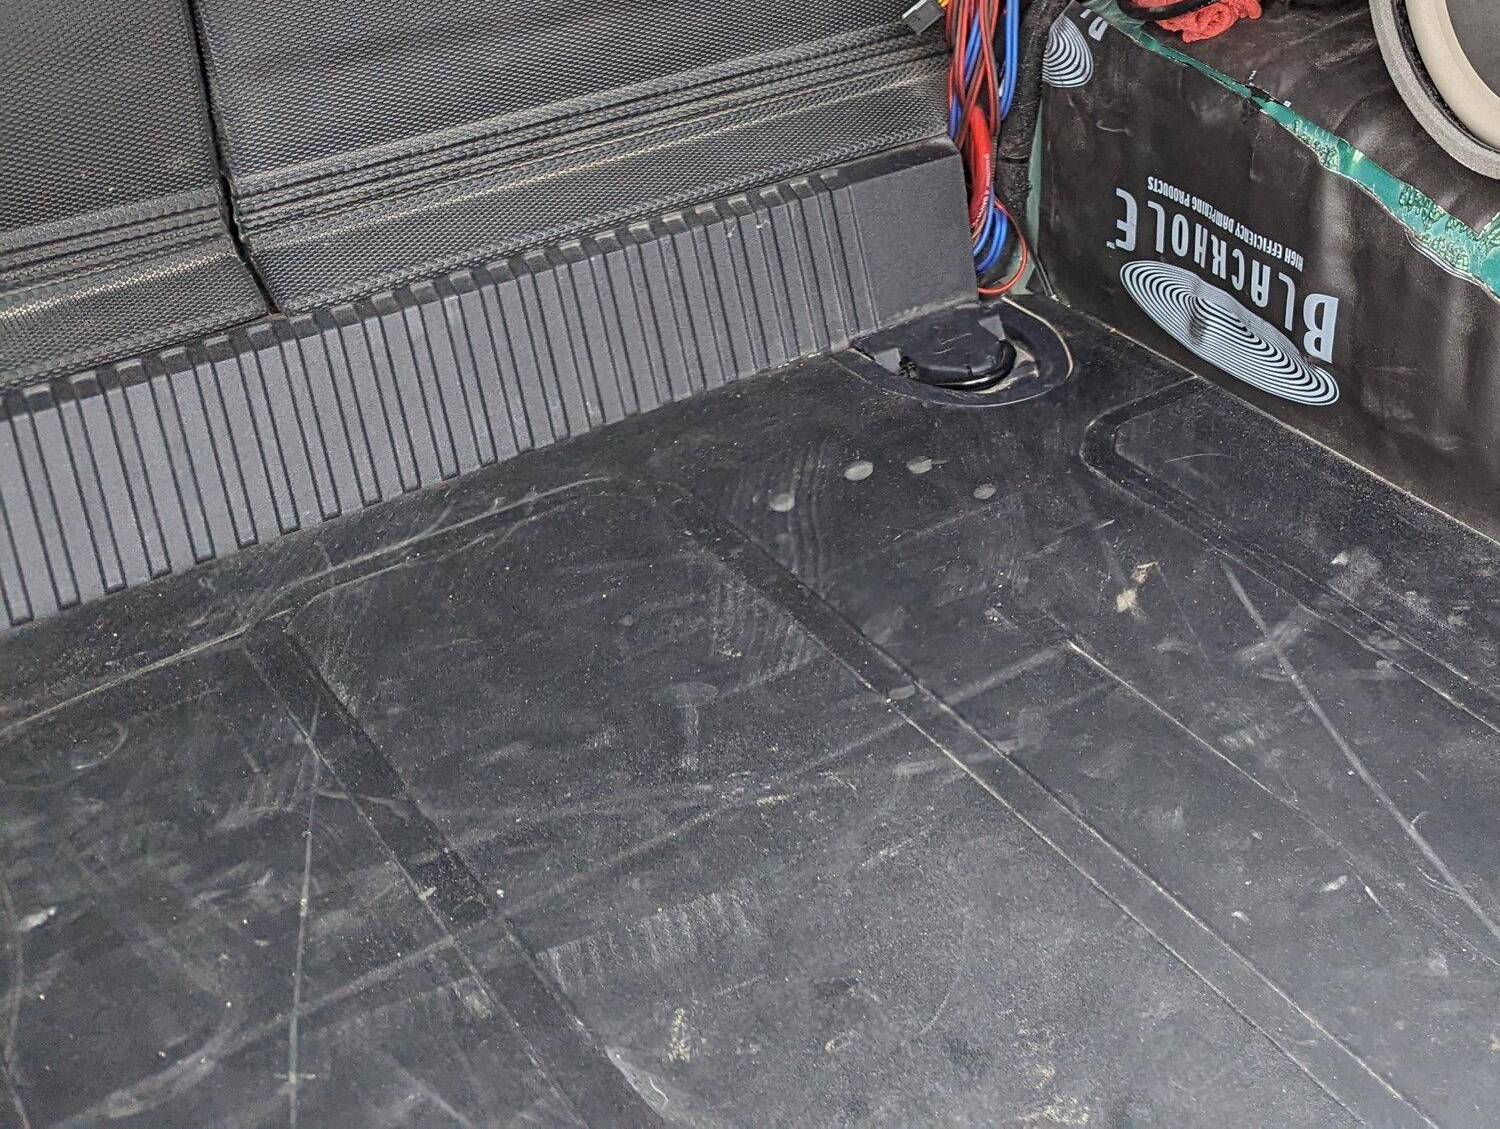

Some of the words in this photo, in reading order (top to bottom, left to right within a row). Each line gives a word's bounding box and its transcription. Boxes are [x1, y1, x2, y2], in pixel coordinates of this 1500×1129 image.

[1146, 176, 1191, 208] PRODUCTS
[1191, 194, 1234, 234] DAMPENING
[1234, 222, 1283, 259] EFFICIENCY
[1115, 187, 1340, 364] BLACKHOLE
[1284, 247, 1304, 273] HIGH
